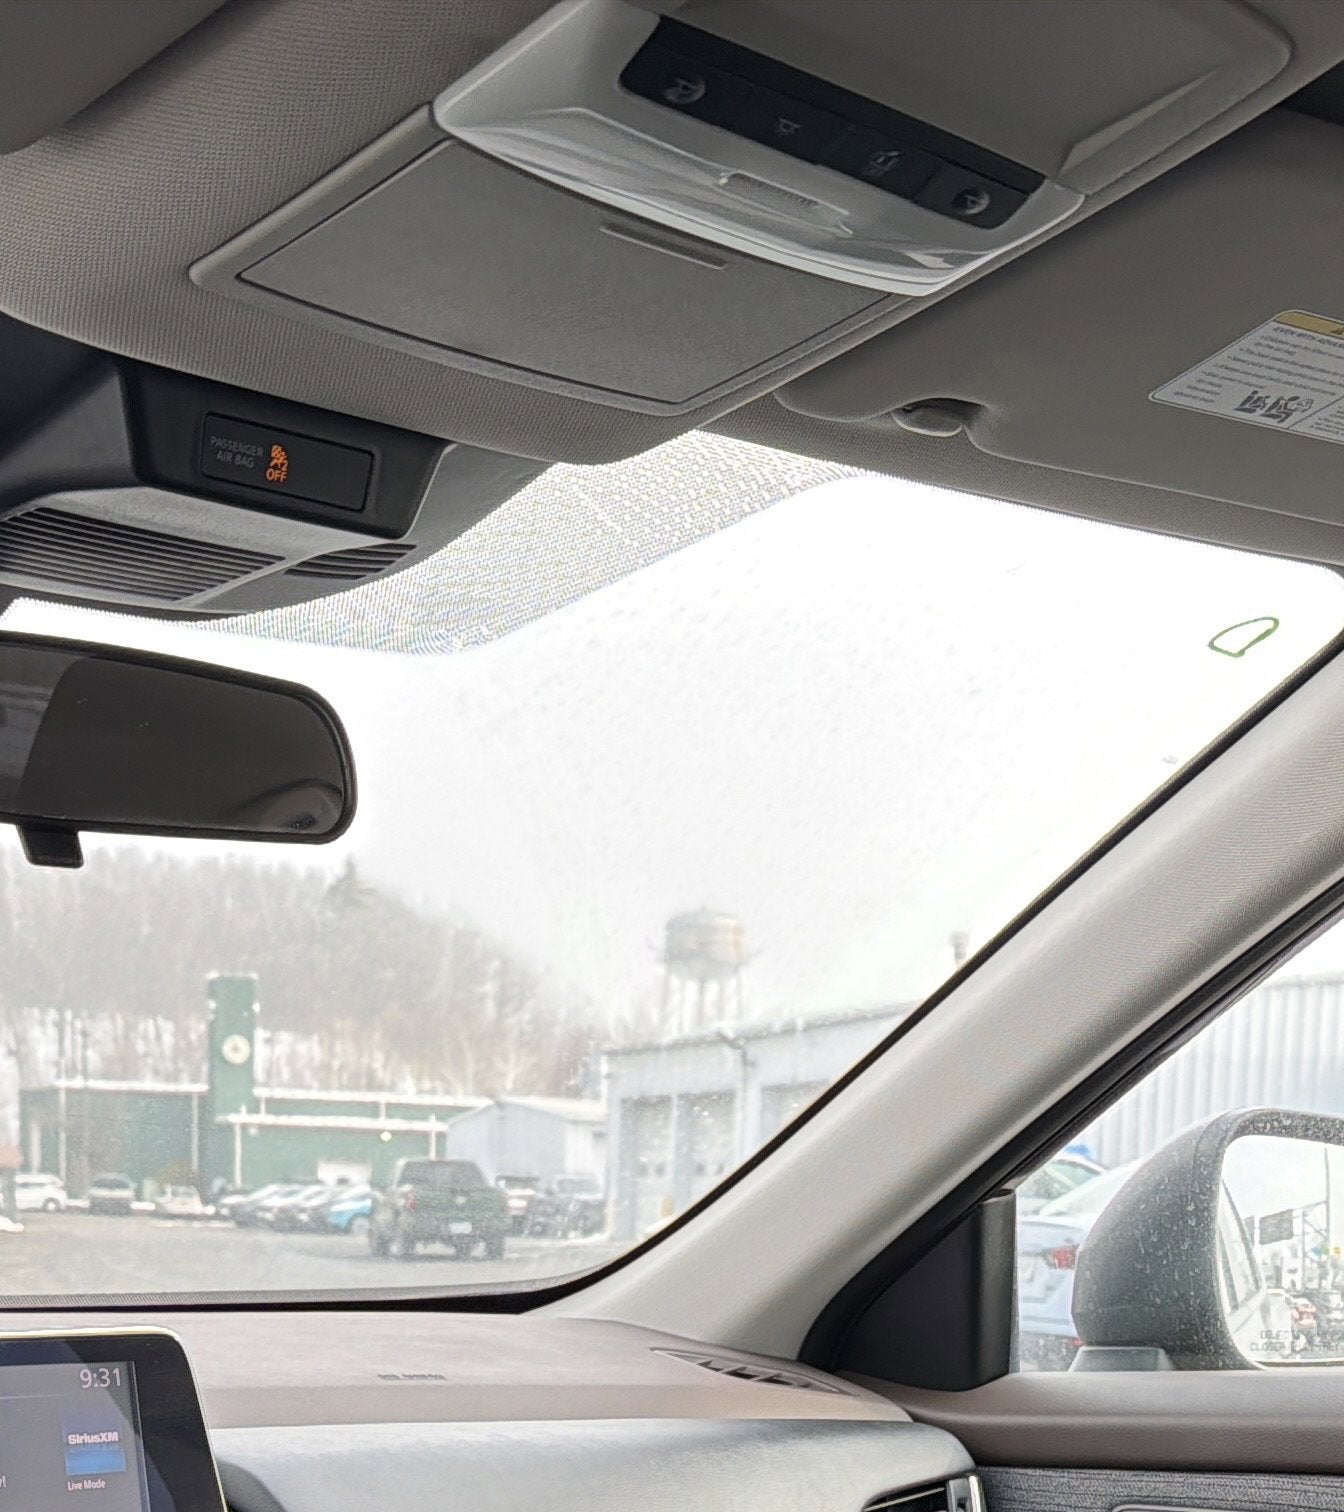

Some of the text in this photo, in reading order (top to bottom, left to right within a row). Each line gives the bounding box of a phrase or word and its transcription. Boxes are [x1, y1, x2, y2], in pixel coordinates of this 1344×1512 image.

[210, 436, 263, 457] PASSENGER
[216, 451, 254, 469] AIR BAG
[266, 468, 288, 483] OFF
[79, 1368, 121, 1389] 9:31
[67, 1479, 106, 1492] Live Mode
